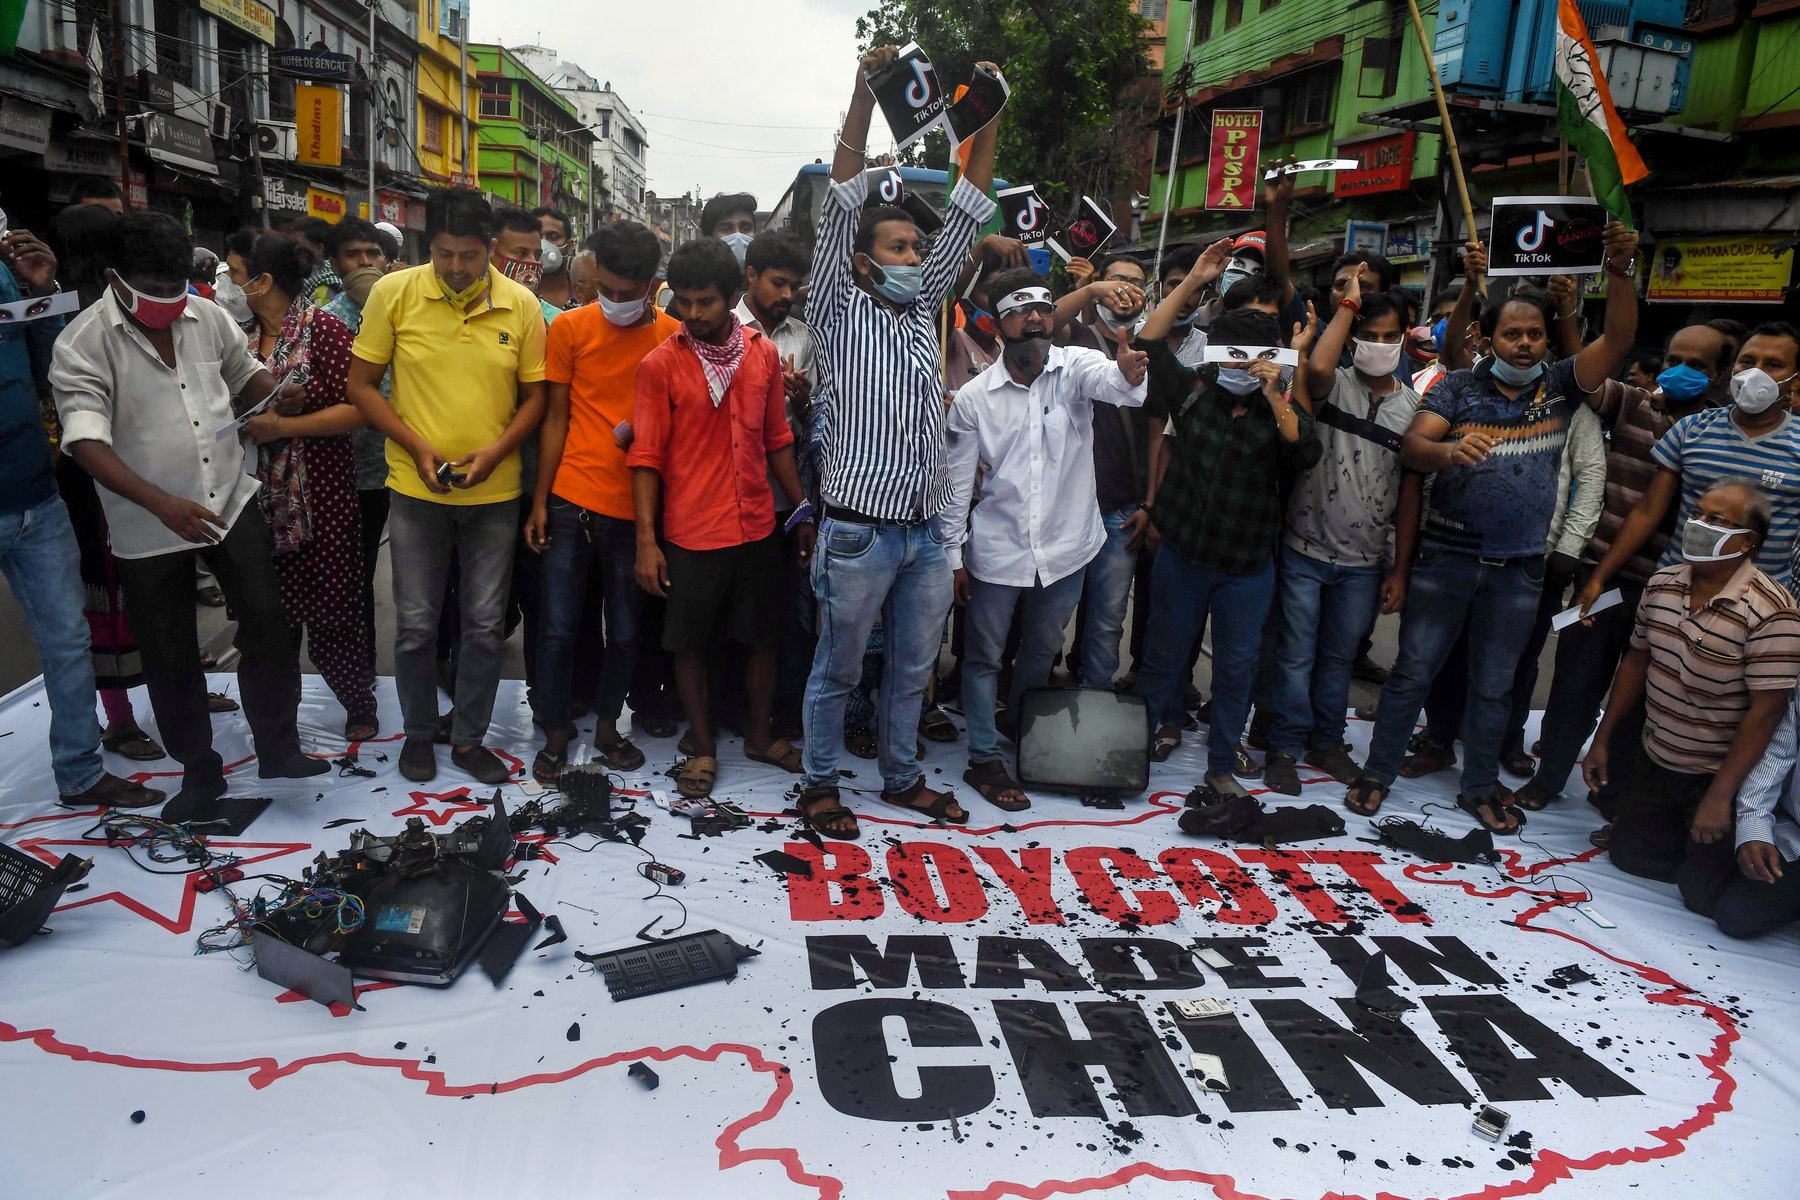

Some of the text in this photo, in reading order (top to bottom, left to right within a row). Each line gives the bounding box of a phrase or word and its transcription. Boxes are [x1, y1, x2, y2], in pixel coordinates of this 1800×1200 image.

[243, 0, 274, 31] BENGAL
[281, 55, 346, 73] HOTEL DE BENGAL
[913, 96, 943, 124] TikTok
[1215, 114, 1260, 127] HOTEL
[311, 97, 322, 160] Khadim's
[1216, 129, 1248, 207] PUSPA
[1514, 253, 1552, 263] TikTok
[1686, 246, 1729, 258] MAATARA
[1730, 243, 1755, 256] CARD
[1761, 474, 1783, 484] SEVEN
[784, 841, 1434, 925] BOYCOTT
[806, 934, 1509, 992] MADE IN
[812, 994, 1646, 1122] CHINA
